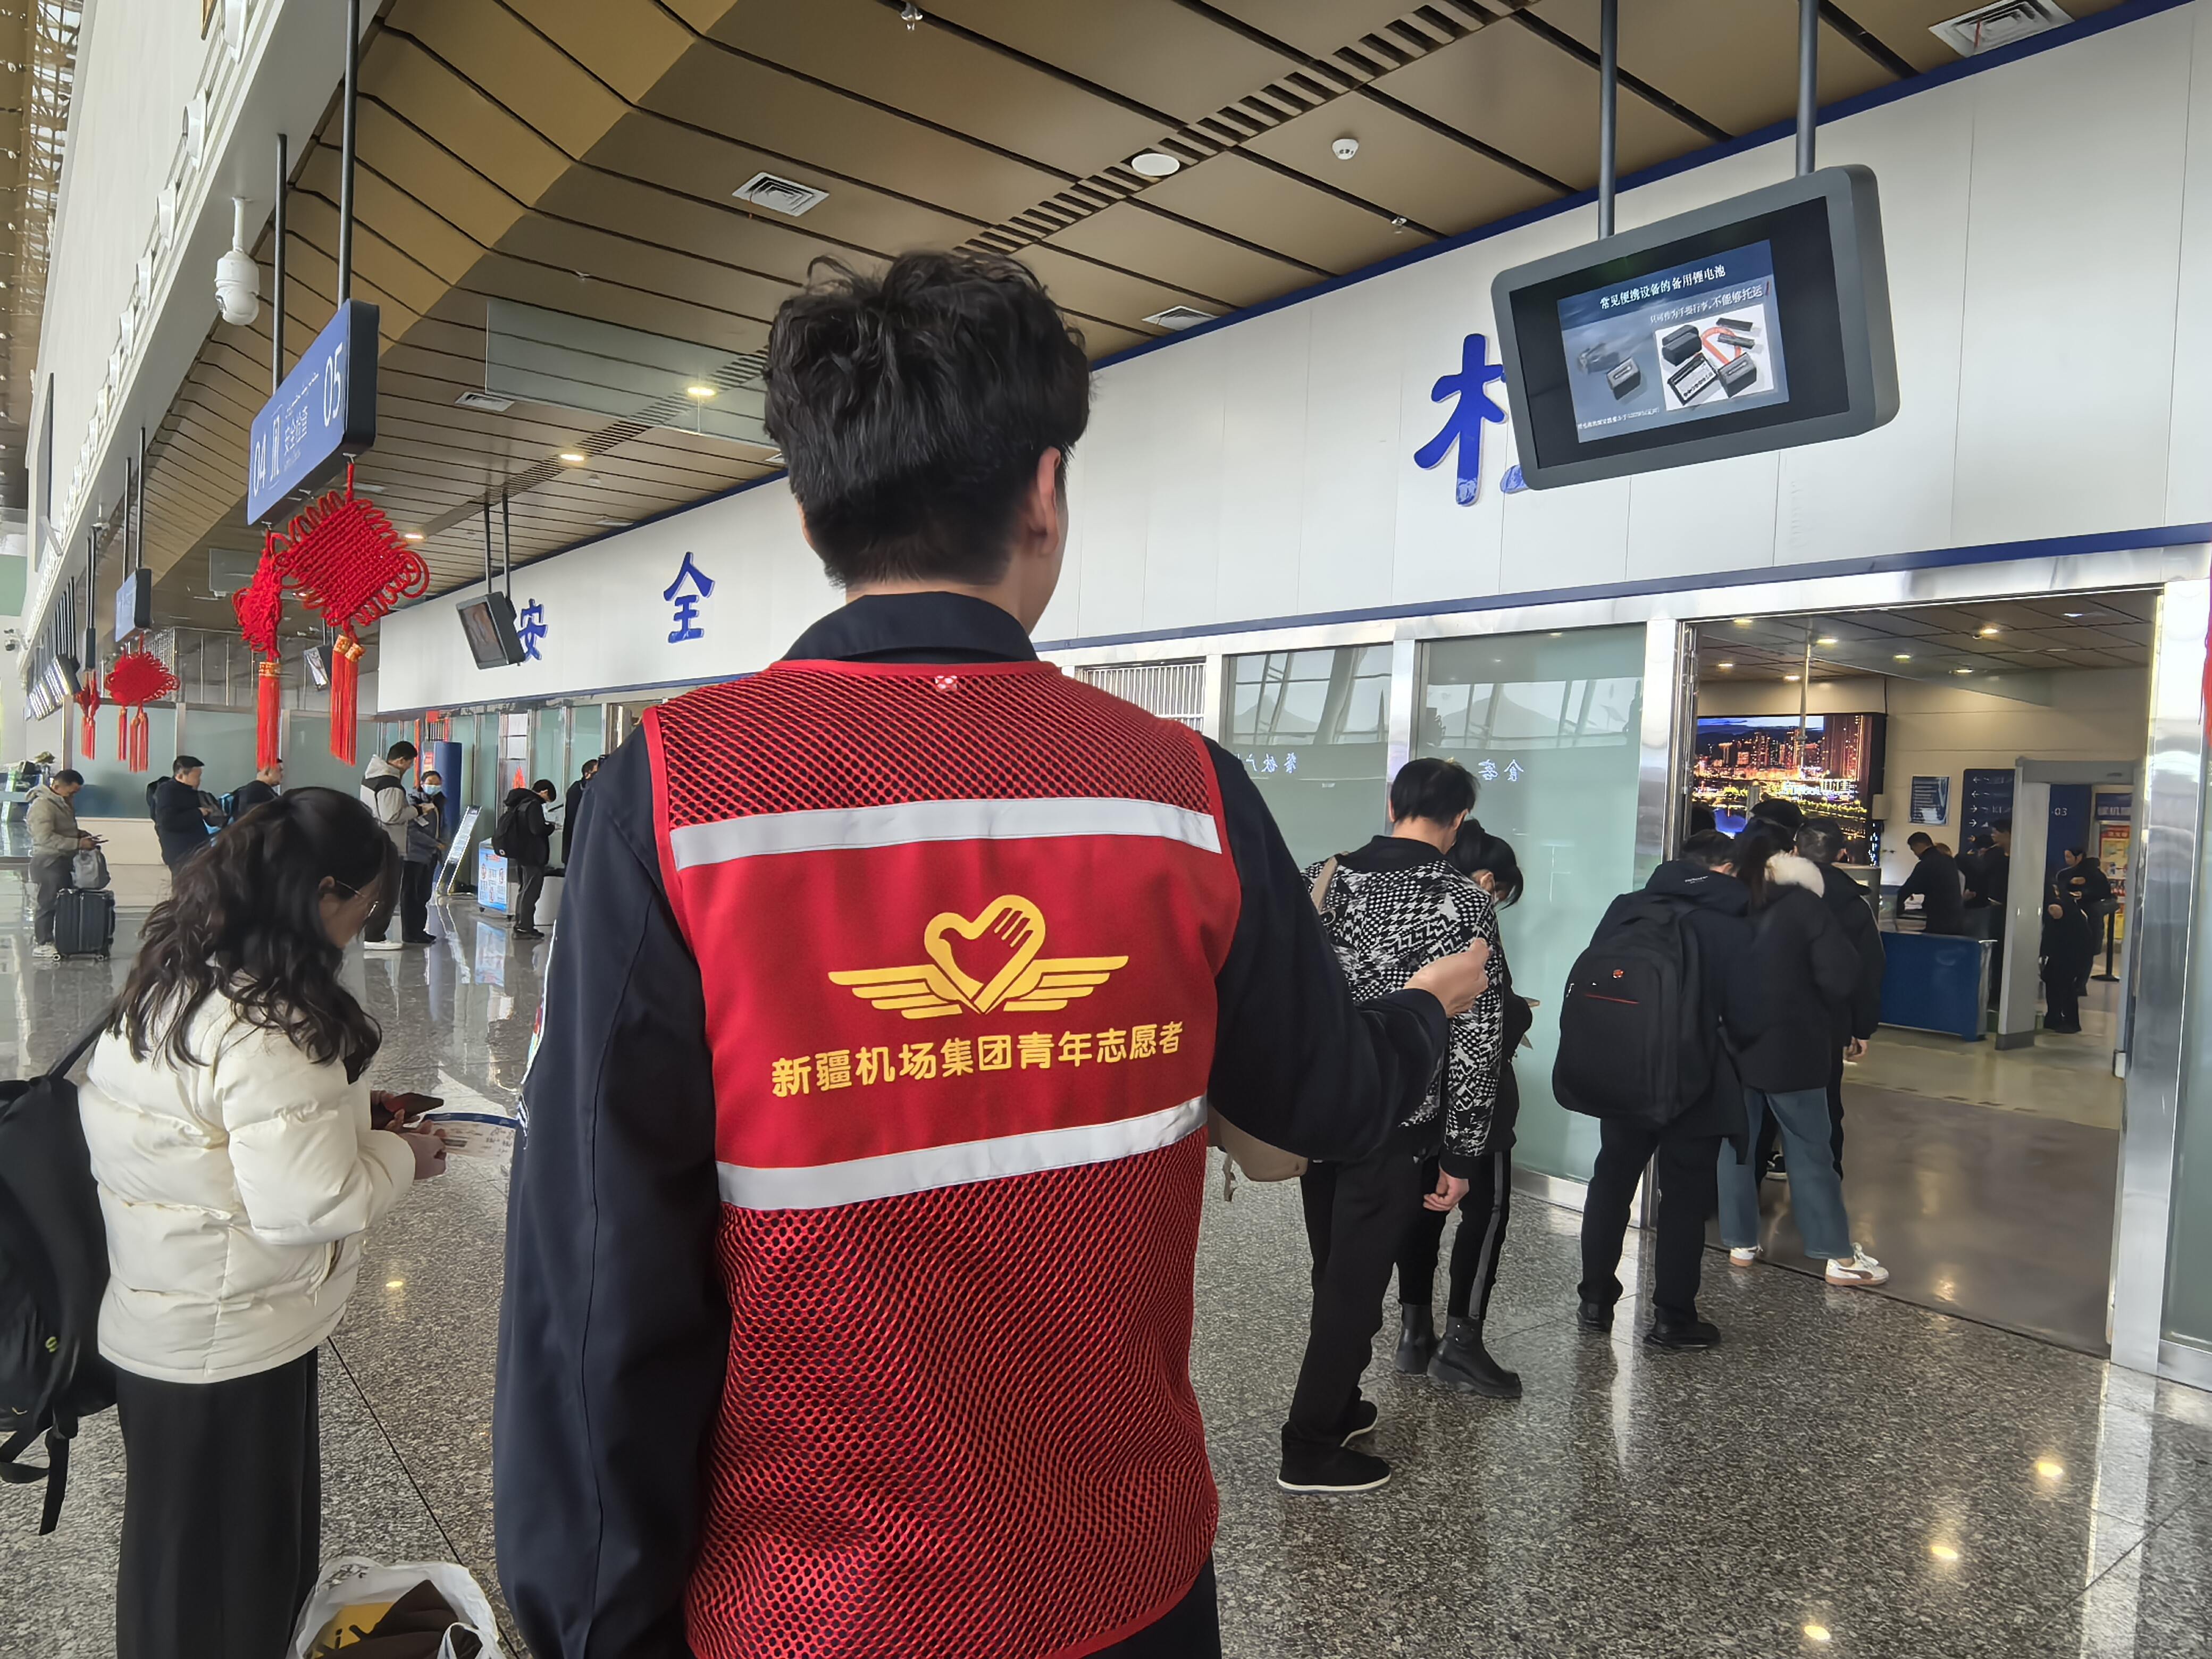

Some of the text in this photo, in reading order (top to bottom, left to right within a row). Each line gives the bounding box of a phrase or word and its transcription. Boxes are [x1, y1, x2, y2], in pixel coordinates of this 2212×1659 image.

[323, 342, 343, 428] 05
[253, 433, 267, 497] 04
[771, 1020, 1184, 1097] 新疆机场集团青年志愿者
